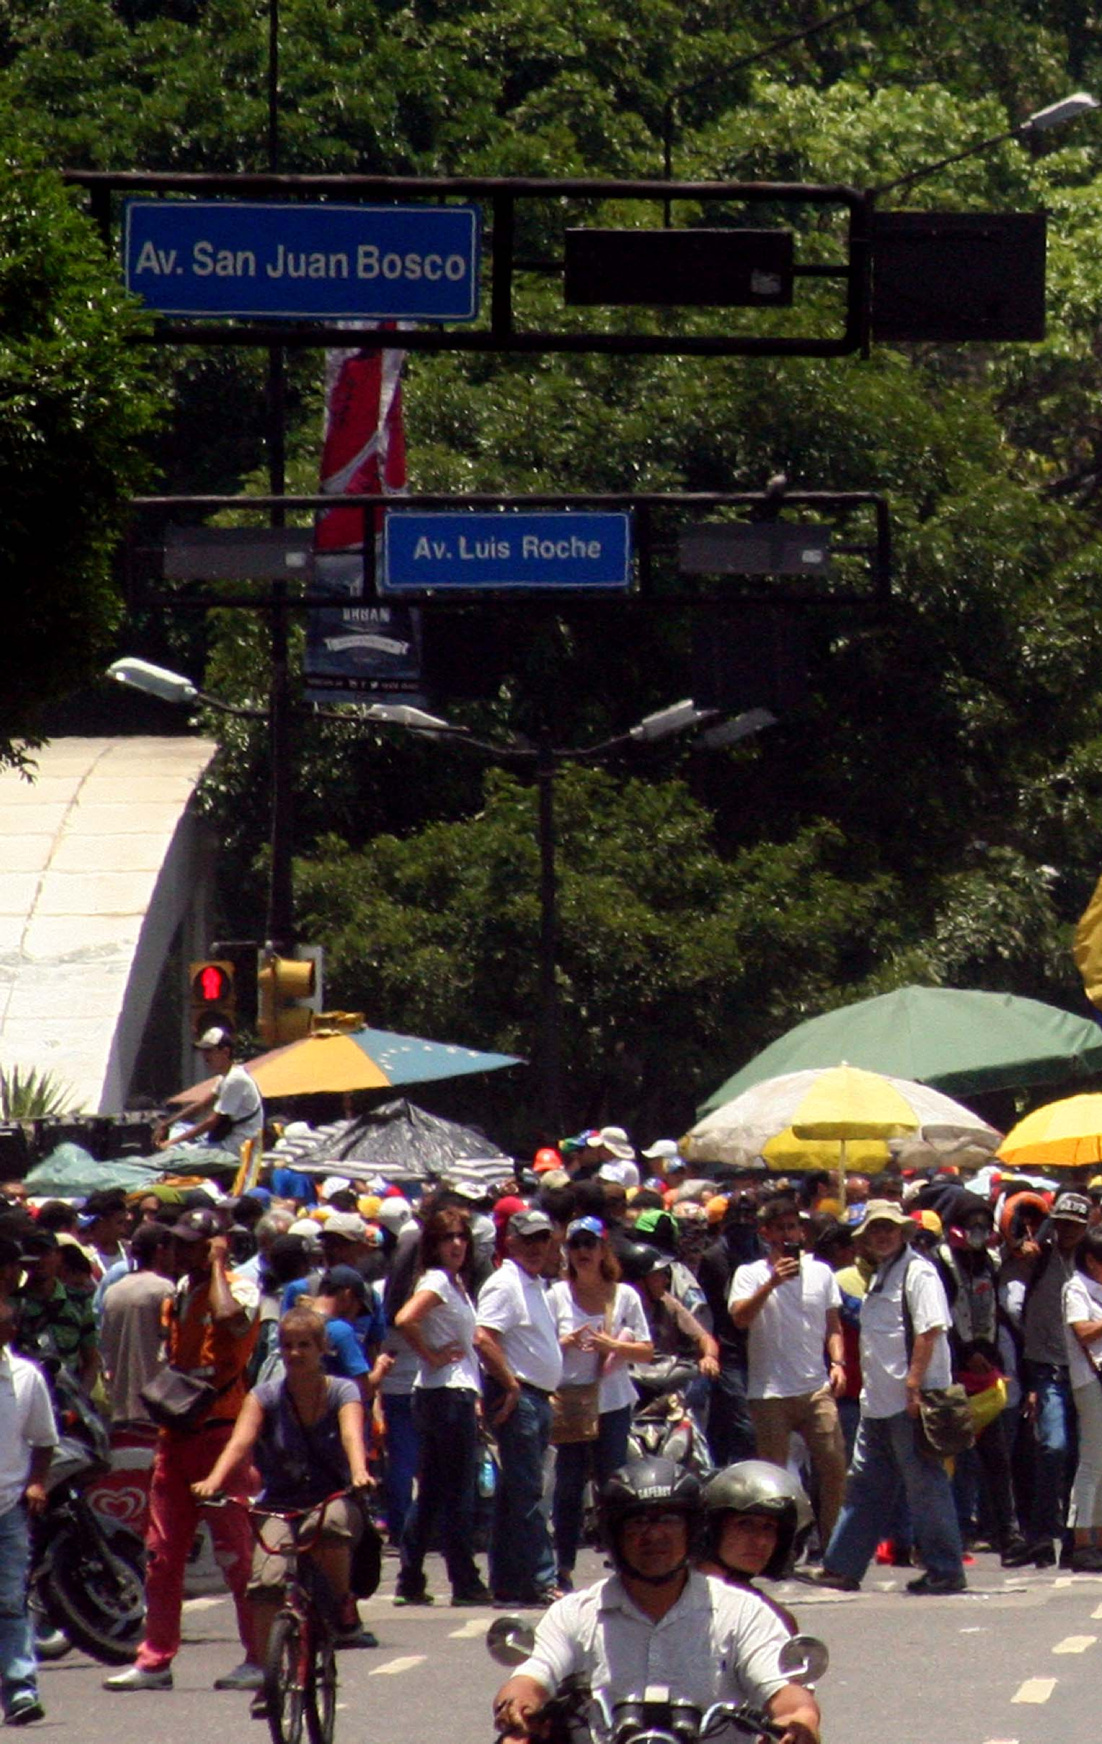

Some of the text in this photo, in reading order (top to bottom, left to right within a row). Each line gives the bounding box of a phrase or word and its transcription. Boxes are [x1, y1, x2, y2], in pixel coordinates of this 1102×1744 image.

[135, 240, 466, 281] Av. San Juan Bosco
[413, 536, 602, 560] Av. Luis Roche
